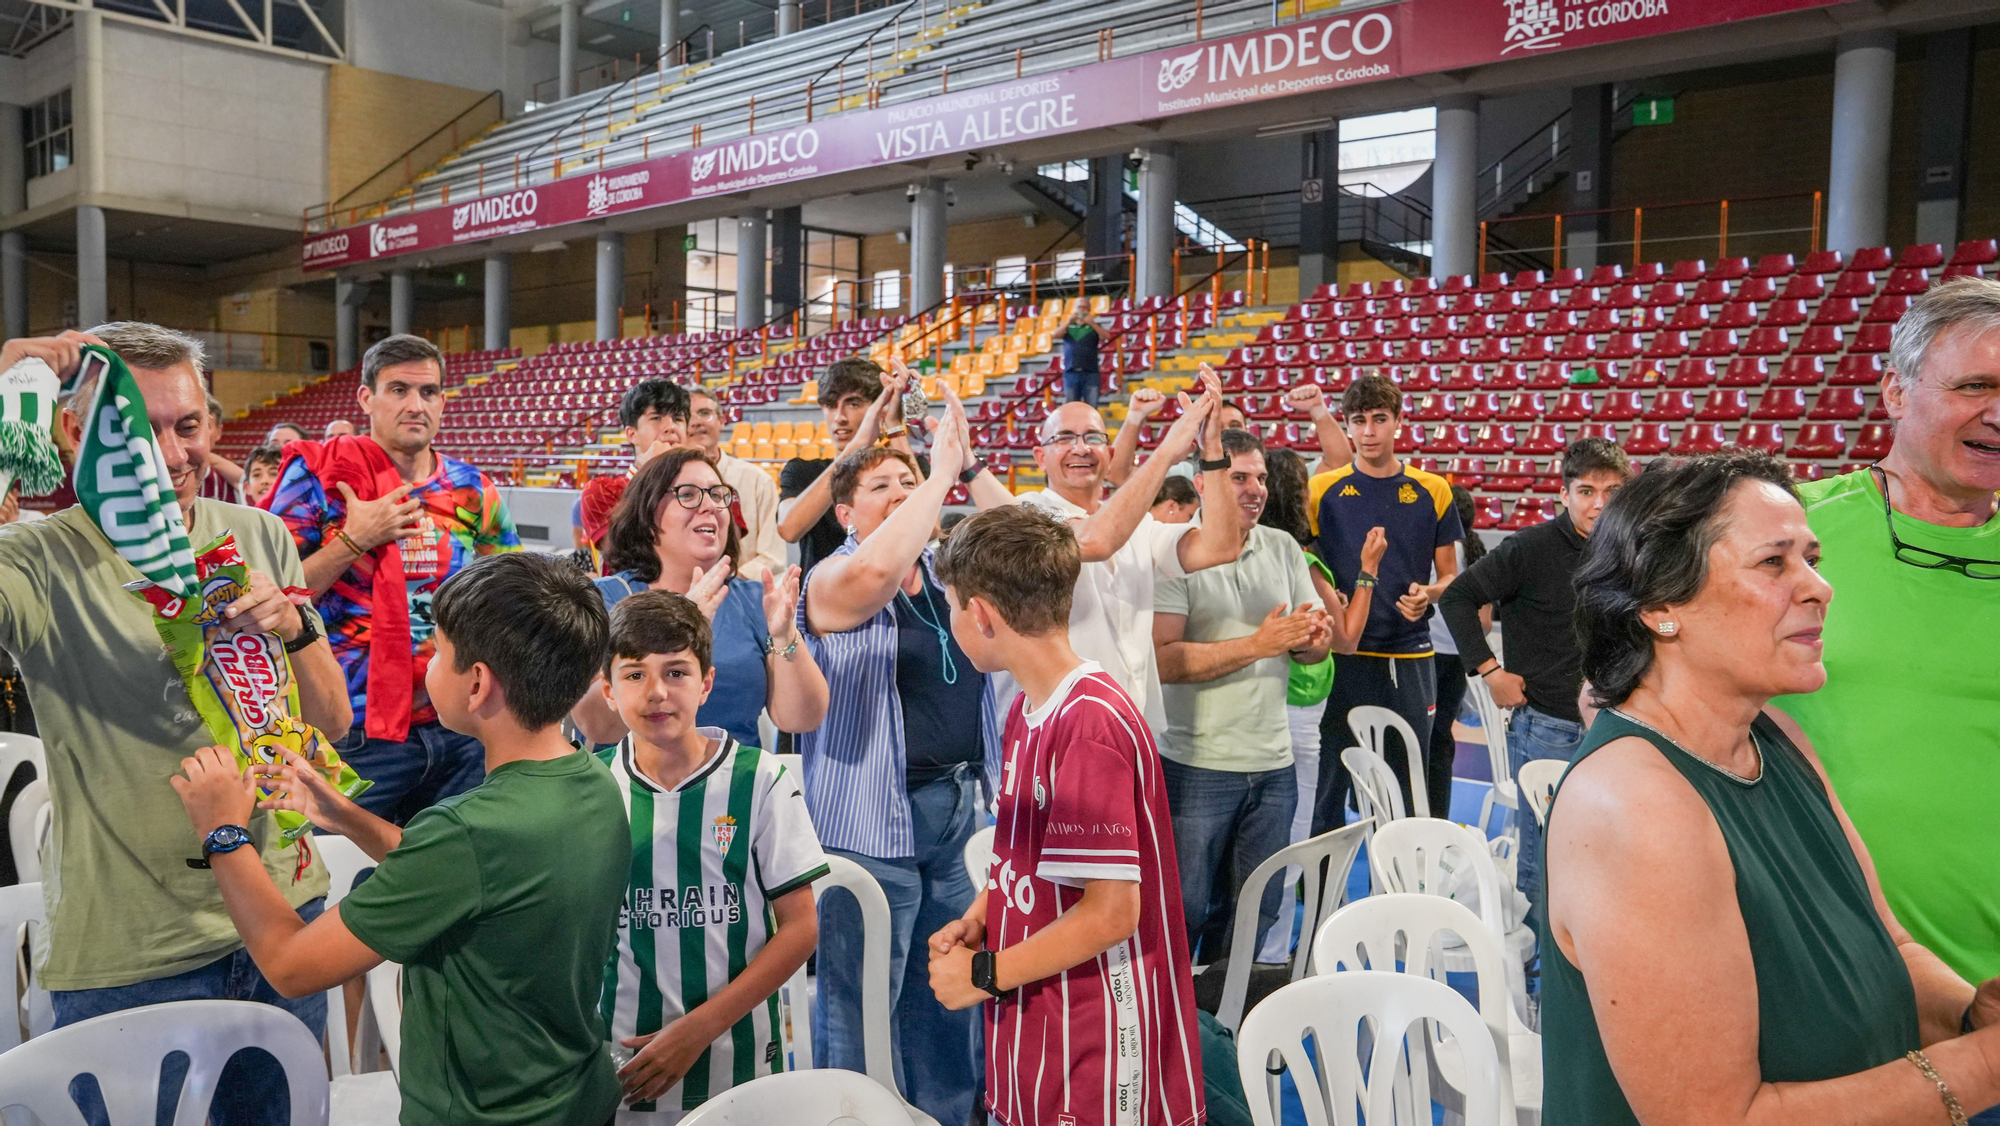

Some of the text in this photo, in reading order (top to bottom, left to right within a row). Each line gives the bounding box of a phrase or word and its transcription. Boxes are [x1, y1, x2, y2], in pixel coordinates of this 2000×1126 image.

[1565, 0, 1669, 32] DE CÓRDOBA
[1207, 12, 1393, 84] IMDECO
[887, 78, 1060, 124] PALACIO MUNICIPAL DEPORTES
[1158, 63, 1390, 112] Instituto Municipal de Deportes Córdoba
[876, 94, 1079, 160] VISTA ALEGRE
[718, 128, 820, 176] IMDECO
[747, 175, 757, 185] de
[469, 189, 538, 226] IMDECO
[311, 233, 350, 257] IMDECO
[213, 647, 264, 724] GREFU
[236, 635, 276, 700] TUBO
